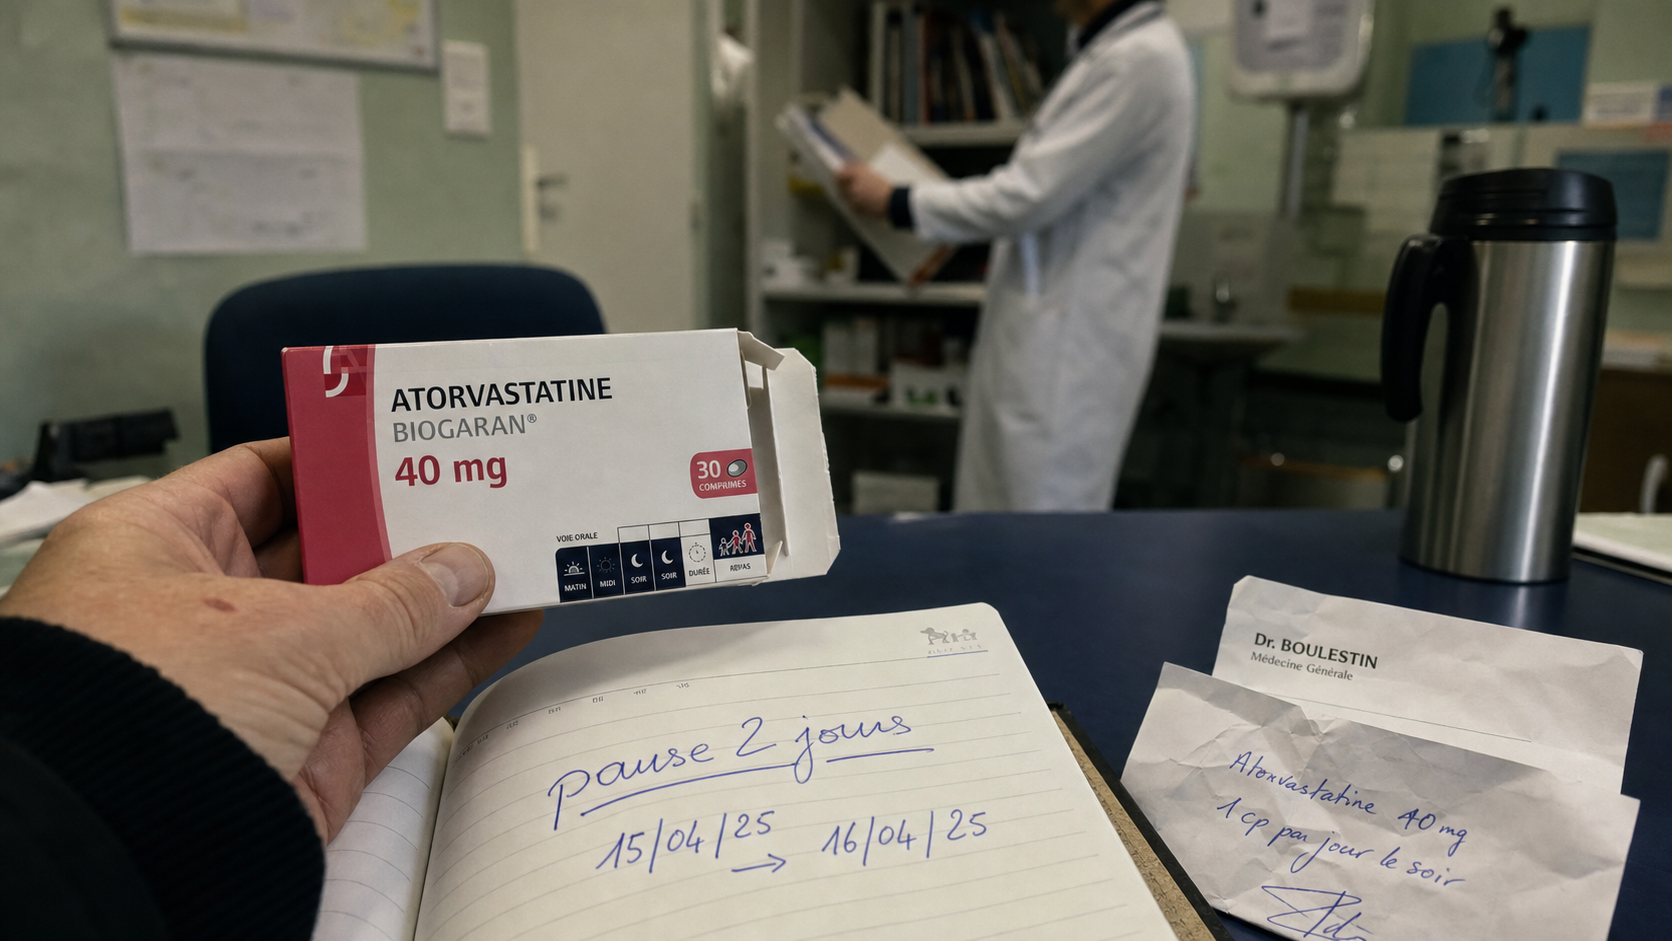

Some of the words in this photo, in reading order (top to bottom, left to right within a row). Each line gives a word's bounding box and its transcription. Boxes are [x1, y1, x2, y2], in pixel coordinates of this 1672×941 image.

[391, 377, 612, 412] ATORVASTATINE
[395, 455, 440, 486] 40
[453, 456, 507, 488] mg
[696, 460, 721, 479] 30
[556, 533, 573, 542] VOIE
[575, 532, 598, 541] ORALE
[600, 580, 616, 588] MIDI
[631, 575, 647, 584] SOIR
[661, 572, 677, 580] SOIR
[688, 567, 710, 576] DURÉE
[564, 583, 587, 592] MATIN
[1254, 632, 1275, 649] Dr.
[1281, 638, 1378, 669] BOULESTIN
[1250, 651, 1303, 671] Médecine
[1306, 663, 1354, 681] Générale
[547, 743, 714, 830] pause
[736, 717, 777, 758] 2
[794, 711, 913, 783] jours
[596, 811, 776, 873] 15/04/25
[822, 809, 988, 867] 16/04/25
[1217, 797, 1242, 818] 1
[1241, 812, 1269, 836] cp
[1290, 830, 1375, 873] jour
[1380, 847, 1400, 869] le
[1406, 861, 1466, 887] soir
[1398, 808, 1436, 831] 40
[1439, 823, 1468, 857] mg
